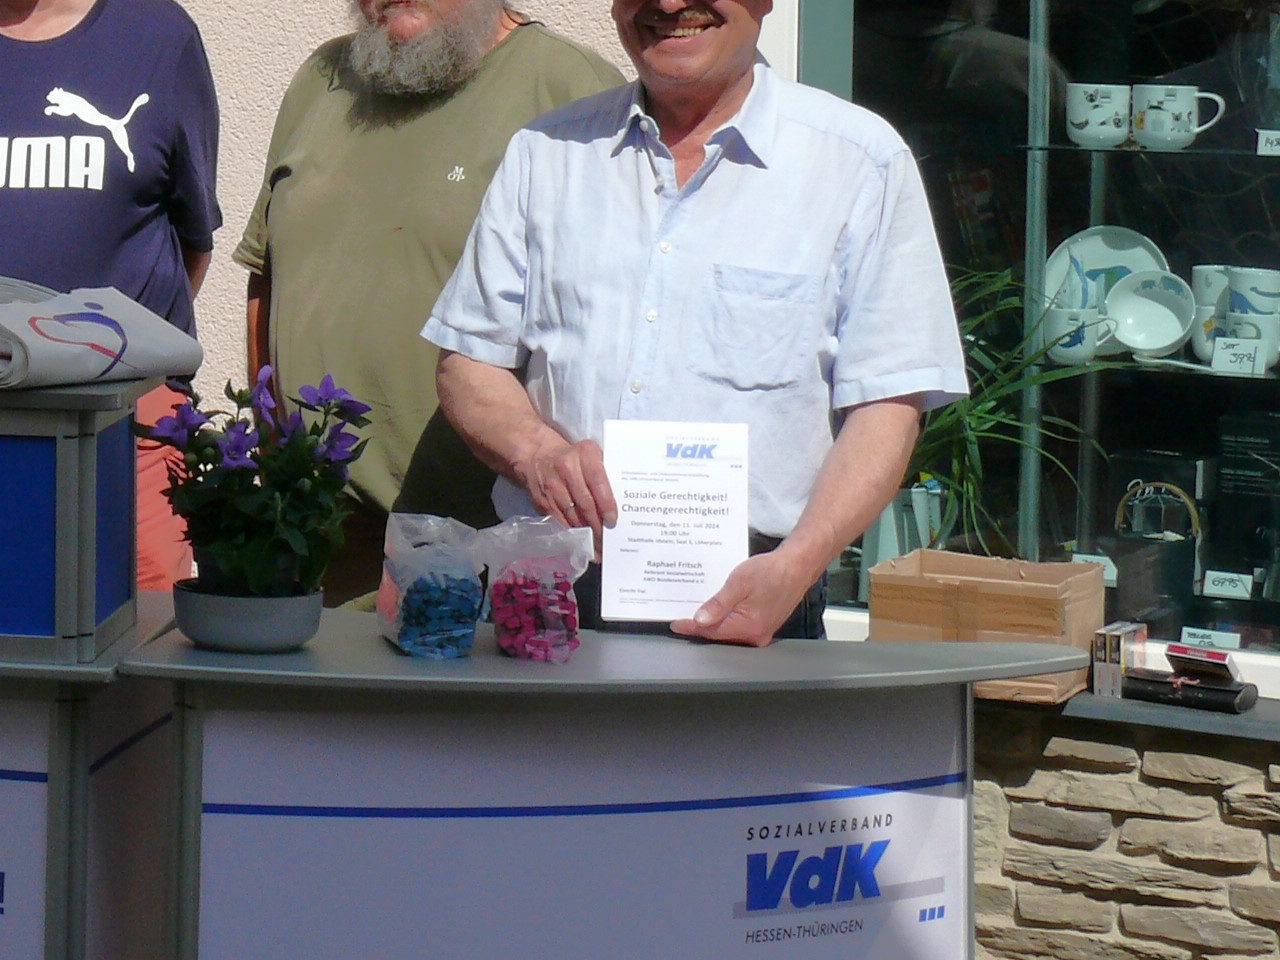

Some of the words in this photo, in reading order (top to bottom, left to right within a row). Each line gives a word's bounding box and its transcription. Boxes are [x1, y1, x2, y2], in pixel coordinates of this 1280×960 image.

[666, 443, 717, 459] VdK
[623, 490, 656, 499] Soziale
[659, 491, 728, 502] Gerechtigkeit!
[621, 503, 729, 516] Chancengerechtigkeit!
[746, 813, 893, 841] SOZIALVERBAND
[746, 839, 891, 912] VdK
[745, 919, 864, 944] HESSEN-THÜRINGEN
